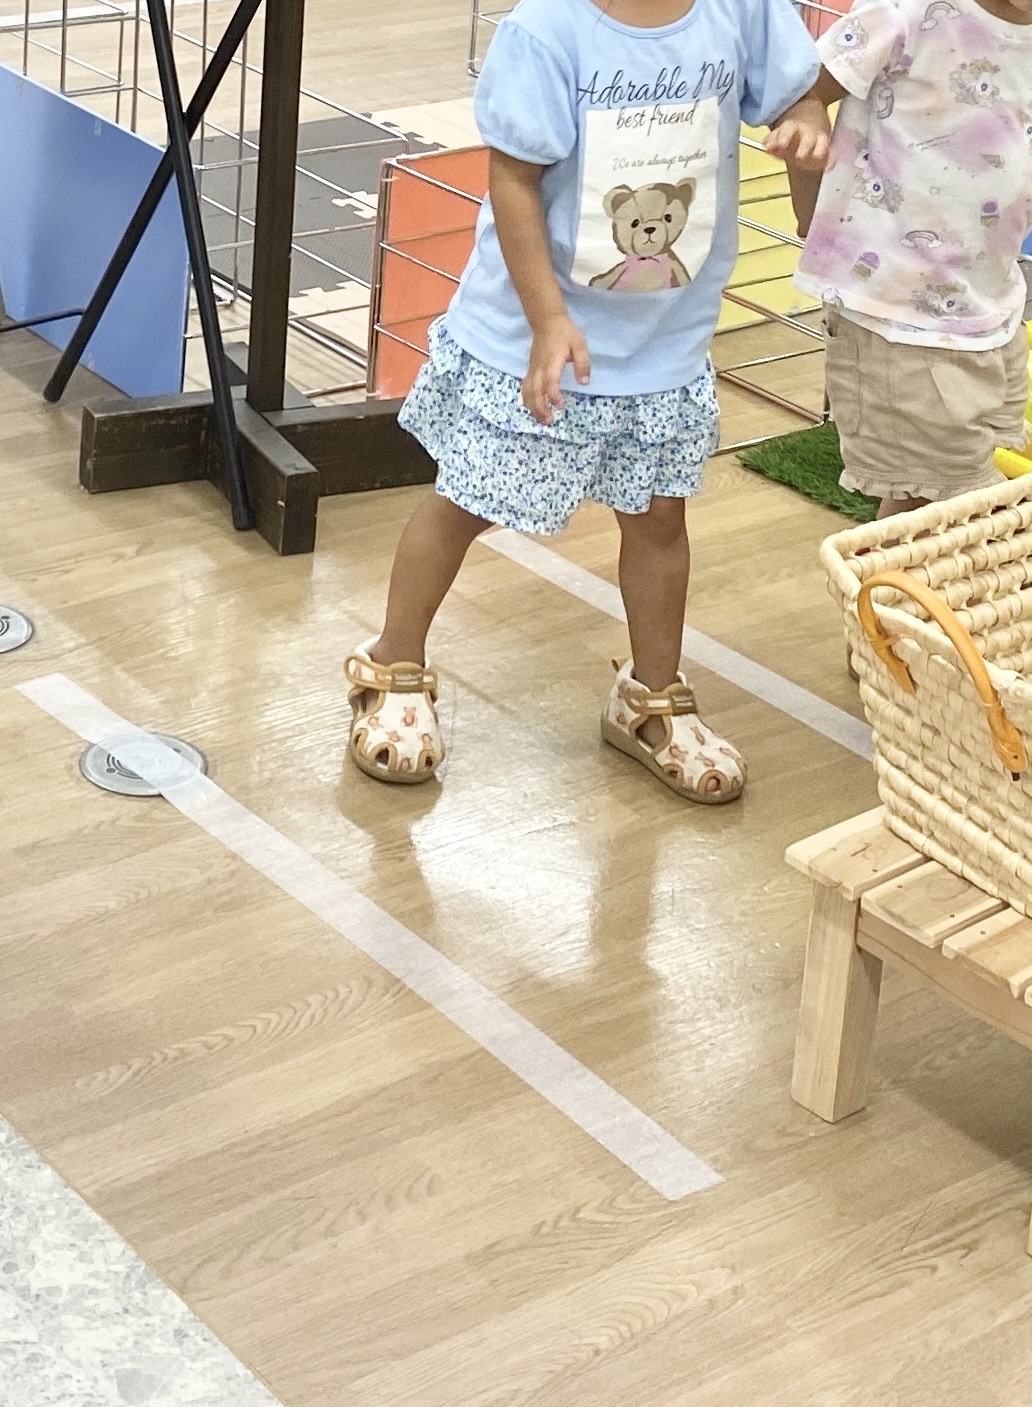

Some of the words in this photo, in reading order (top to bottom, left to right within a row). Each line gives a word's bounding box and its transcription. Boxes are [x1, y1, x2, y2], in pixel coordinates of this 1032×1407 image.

[576, 64, 688, 110] Adorable
[692, 59, 736, 106] My
[616, 105, 646, 130] best
[647, 99, 698, 137] friend
